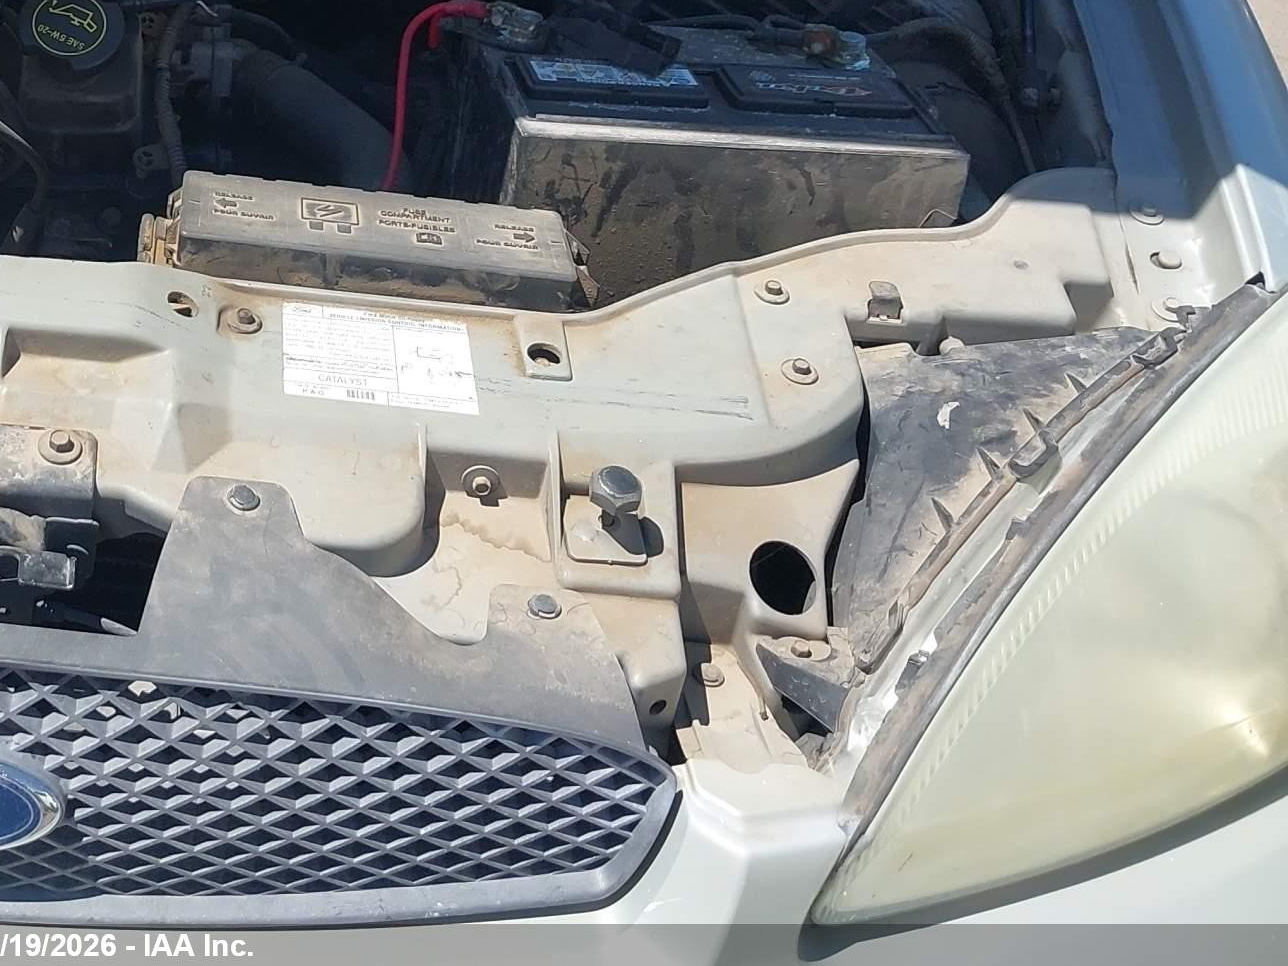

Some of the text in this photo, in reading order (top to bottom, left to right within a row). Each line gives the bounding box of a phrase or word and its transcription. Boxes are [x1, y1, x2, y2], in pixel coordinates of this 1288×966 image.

[37, 24, 85, 50] SAE 5W-20
[214, 191, 254, 201] RELEASE
[213, 208, 239, 217] POUR
[379, 210, 451, 224] COMPARTMENT
[377, 219, 456, 234] PORTE-FUSIBLES
[494, 223, 535, 233] RELEASE
[317, 373, 368, 387] CATALYST
